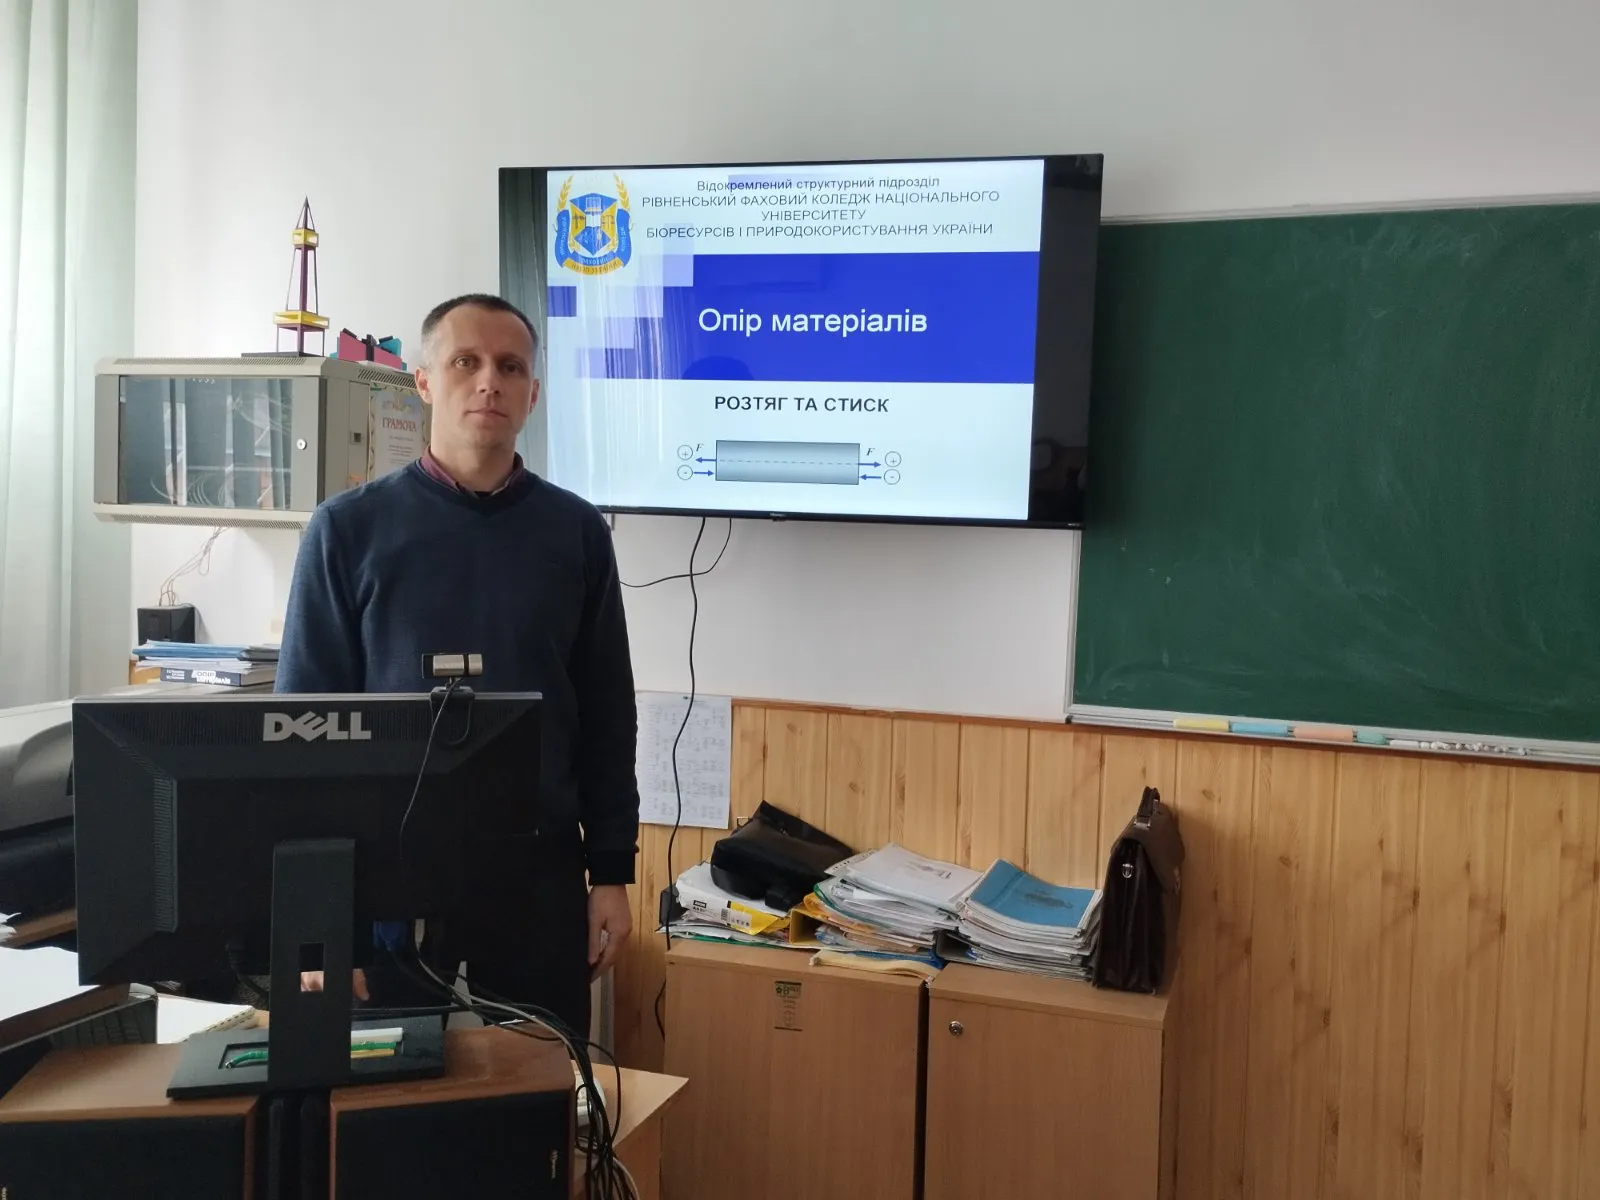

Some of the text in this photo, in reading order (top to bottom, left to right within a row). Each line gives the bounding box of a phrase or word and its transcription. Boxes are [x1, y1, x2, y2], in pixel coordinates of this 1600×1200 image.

[697, 176, 940, 193] Відокремлений структурний підрозділ
[642, 191, 1000, 208] РІВНЕНСЬКИЙ ФАХОВИЙ КОЛЕДЖ НАЦІОНАЛЬНОГО
[761, 209, 867, 222] УНІВЕРСИТЕТУ
[646, 226, 735, 239] БІОРЕСУРСІВ
[746, 224, 928, 239] ПРИРОДОКОРИСТУВАННЯ
[932, 222, 993, 236] УКРАЇНИ
[698, 308, 928, 338] Опір матеріалів
[714, 396, 889, 412] РОЗТЯГ ТА СТИСК
[381, 417, 417, 432] ГРАМОТА
[262, 711, 372, 742] DELL
